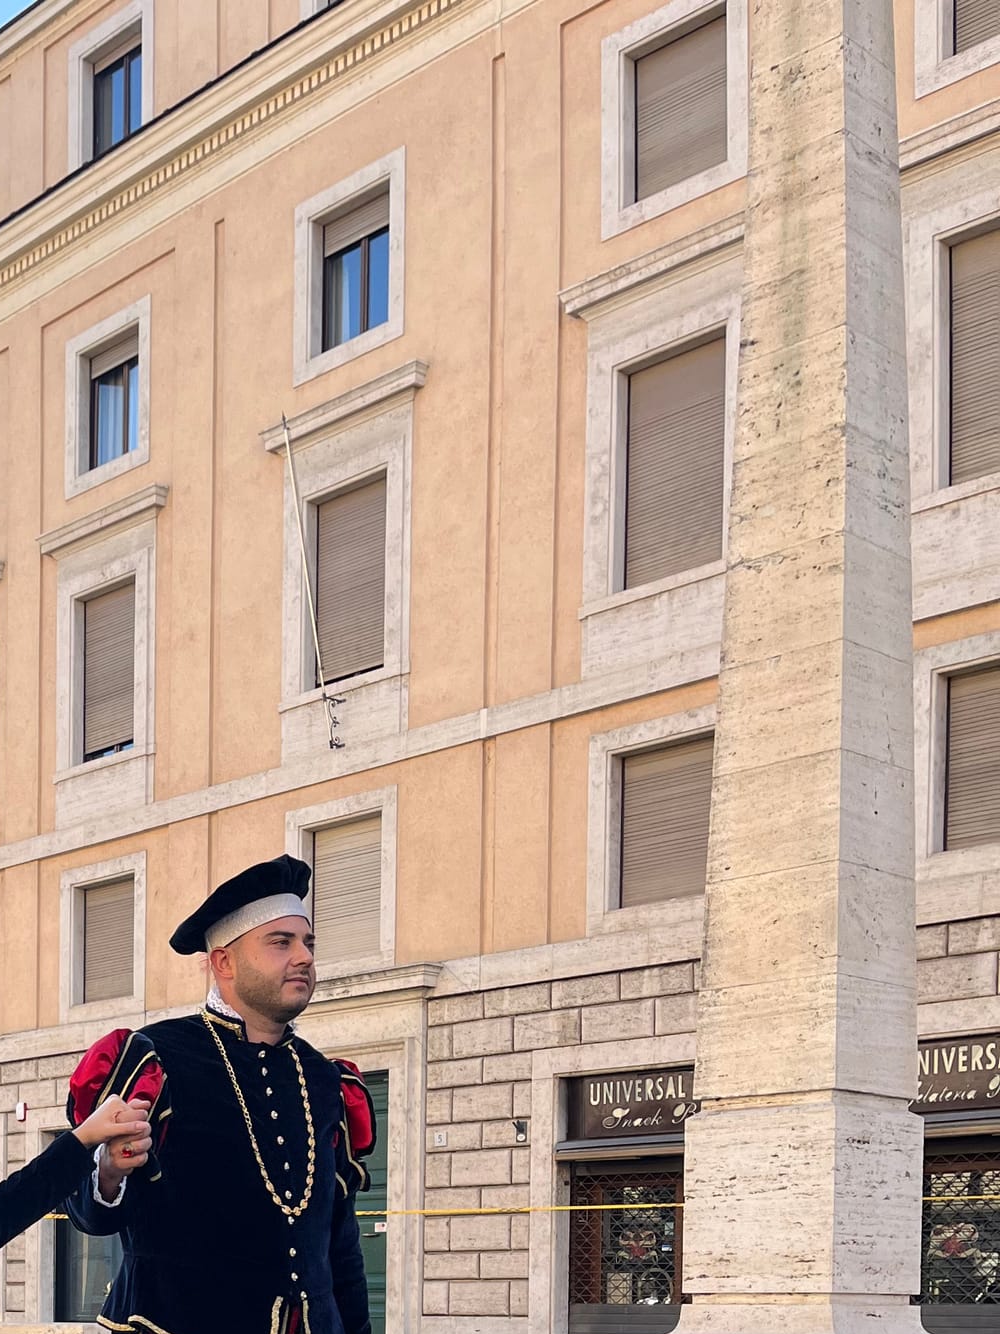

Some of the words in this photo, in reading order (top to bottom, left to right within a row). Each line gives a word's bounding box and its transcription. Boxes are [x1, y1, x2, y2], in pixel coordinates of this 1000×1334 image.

[918, 1042, 1000, 1075] NIVERS
[590, 1075, 686, 1106] UNIVERSAL
[908, 1081, 977, 1107] elateria
